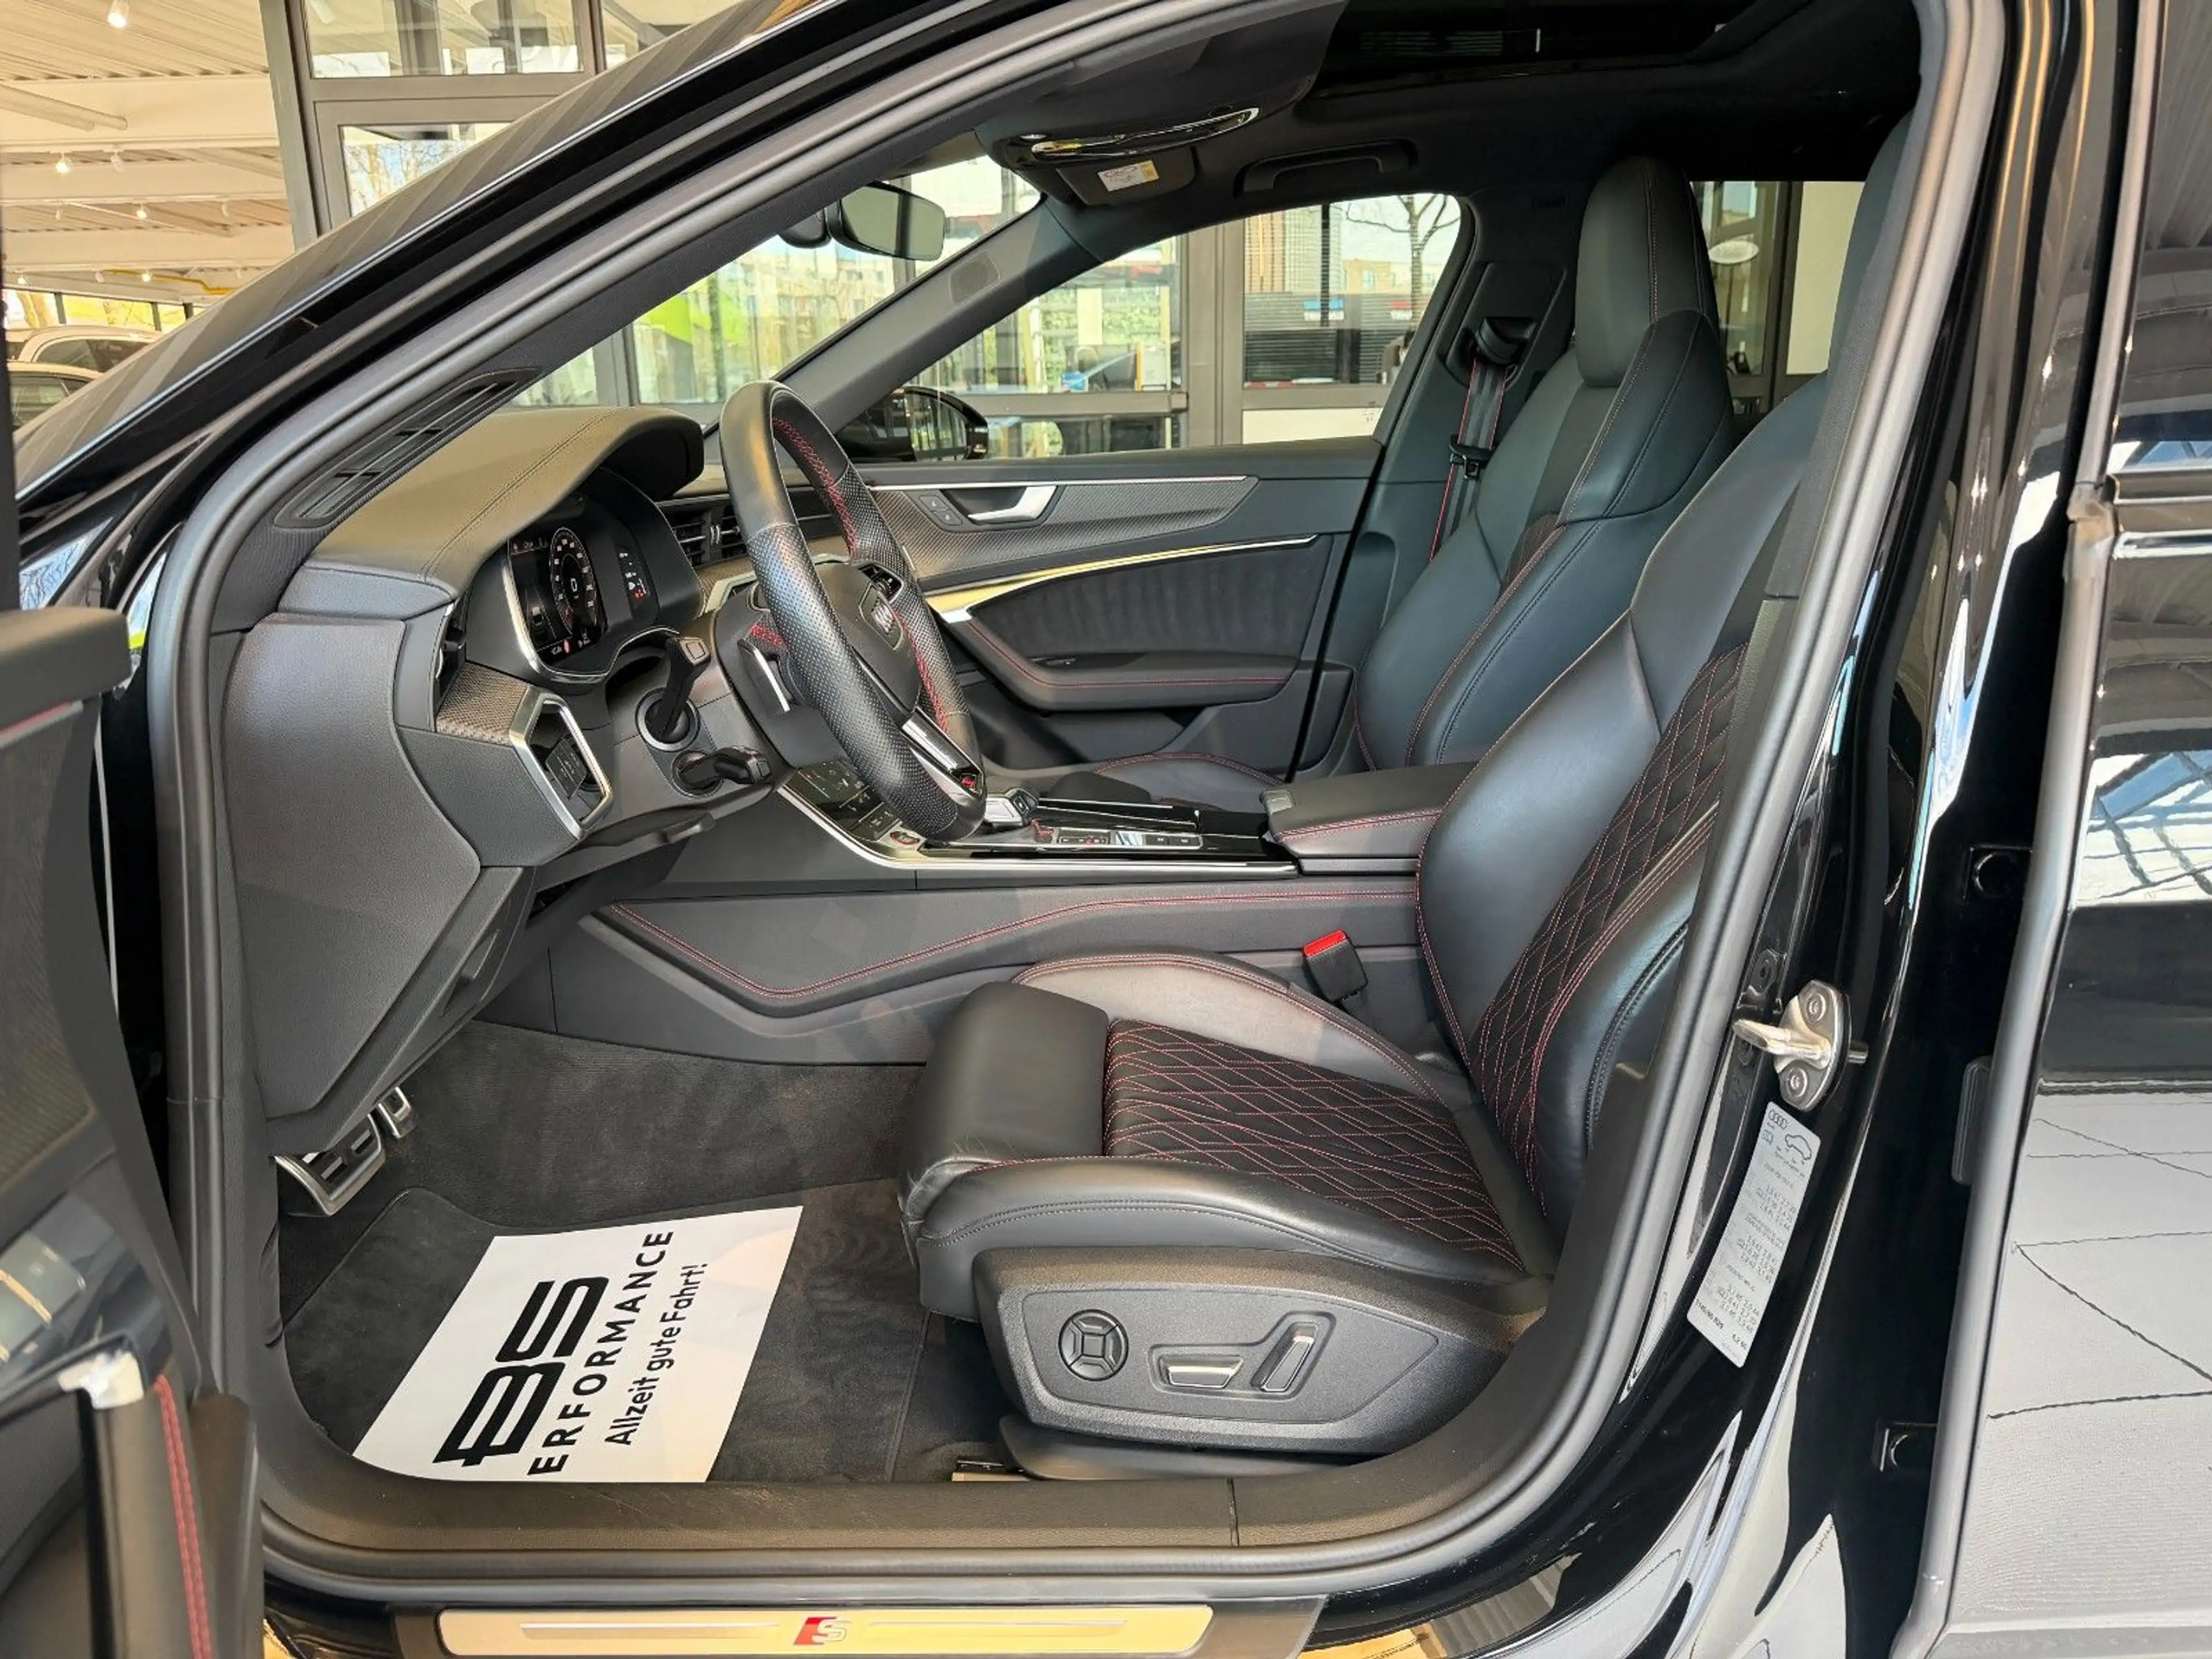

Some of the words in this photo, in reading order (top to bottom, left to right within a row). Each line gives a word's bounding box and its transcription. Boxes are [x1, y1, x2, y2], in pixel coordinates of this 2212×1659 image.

[660, 1264, 707, 1323] Fahrt!
[527, 1232, 674, 1475] ERFORMANCE
[646, 1327, 681, 1371] gute
[604, 1377, 660, 1445] Allzeit
